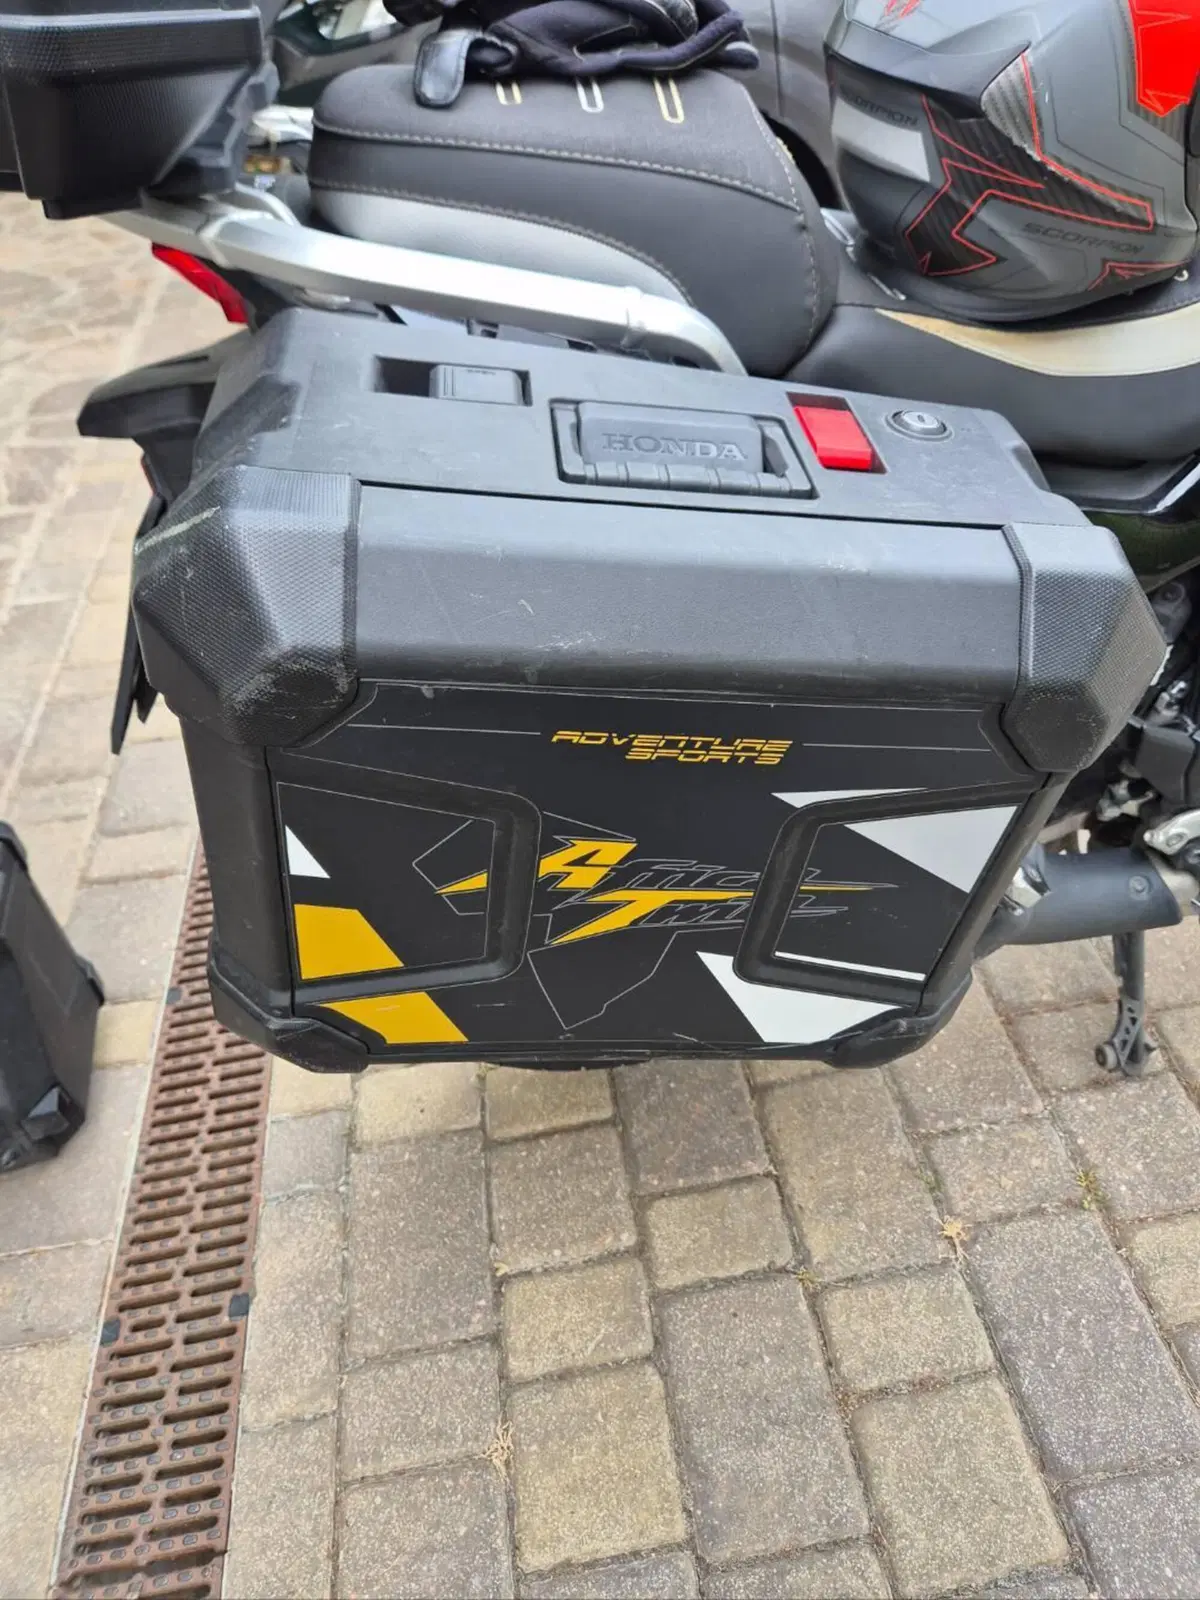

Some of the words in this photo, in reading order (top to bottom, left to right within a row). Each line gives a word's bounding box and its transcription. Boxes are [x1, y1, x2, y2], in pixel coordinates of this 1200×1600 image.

[1021, 222, 1145, 254] SCORPION
[601, 433, 749, 461] HONDA
[551, 730, 793, 752] ADVENTURE
[625, 748, 785, 765] SPORTS
